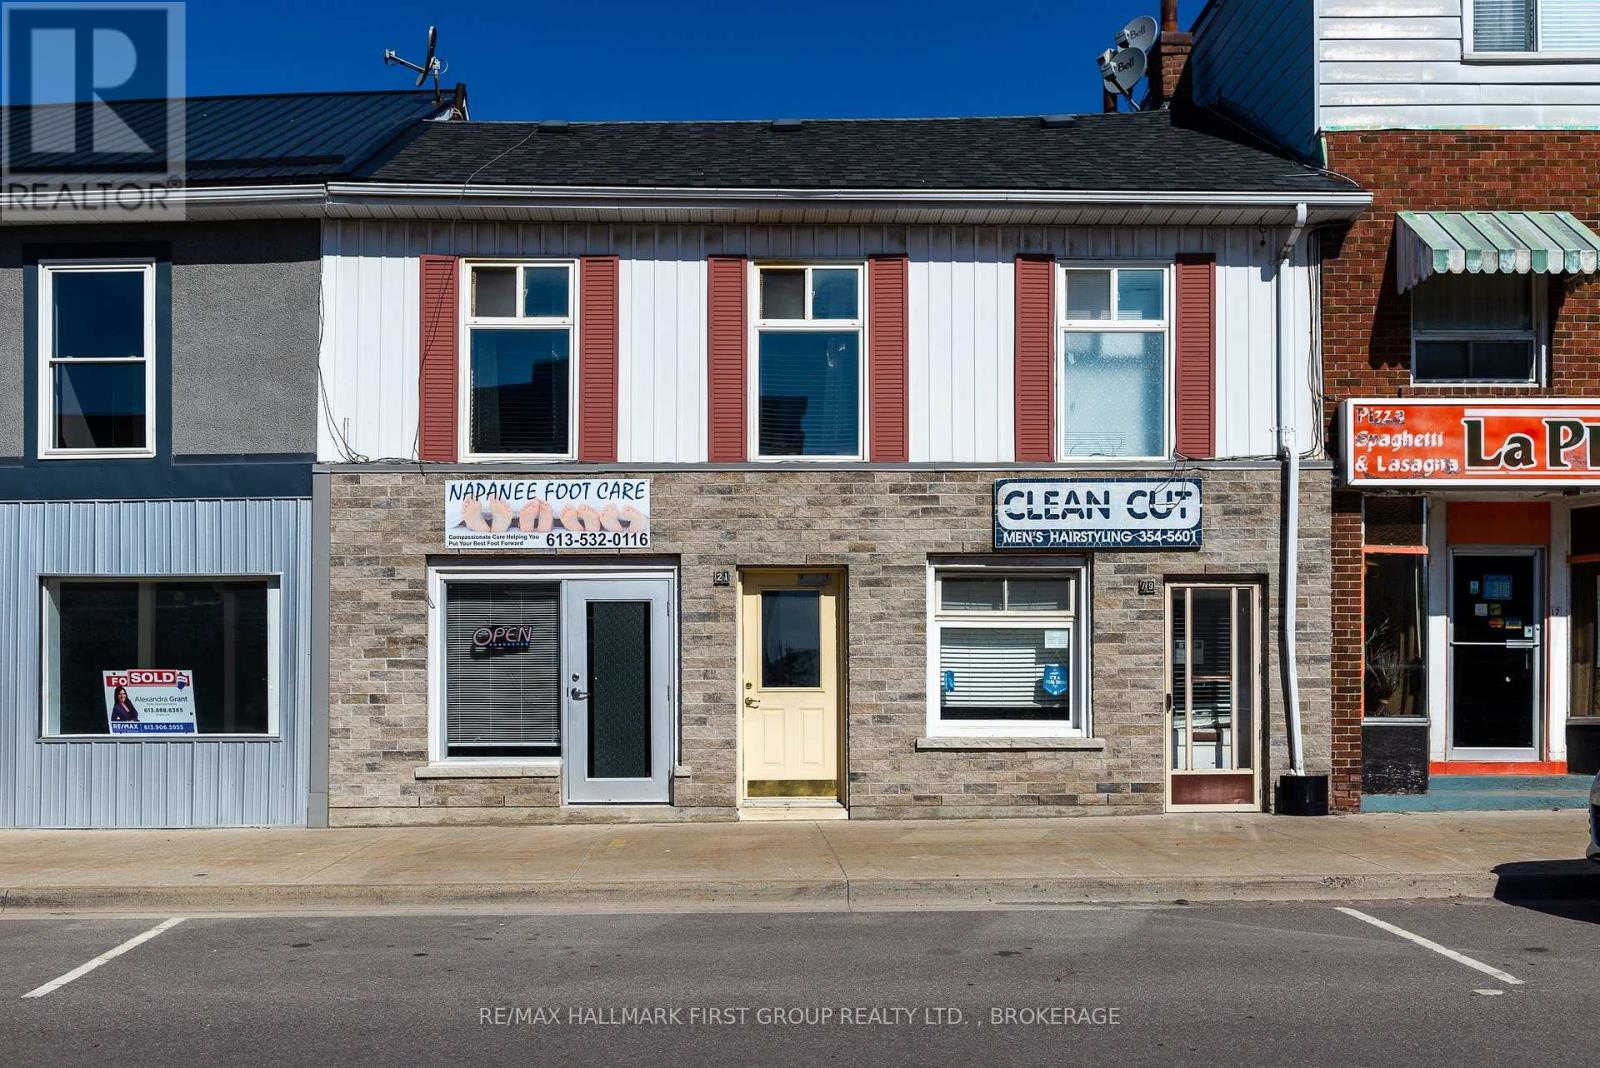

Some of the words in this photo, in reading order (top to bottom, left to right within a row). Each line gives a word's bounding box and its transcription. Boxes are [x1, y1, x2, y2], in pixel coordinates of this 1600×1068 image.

[1130, 25, 1146, 39] Bell
[1117, 57, 1135, 72] Bell
[1356, 406, 1405, 425] Pizza
[1355, 431, 1444, 452] Spaghetti
[1461, 417, 1537, 470] La
[1355, 456, 1368, 473] &
[1377, 455, 1459, 476] Lasagna
[450, 481, 537, 501] NAPANEE
[544, 481, 591, 501] FOOT
[597, 481, 645, 500] CARE
[1003, 489, 1111, 521] CLEAN
[1126, 489, 1193, 520] CUT
[448, 533, 491, 541] Compassionate
[506, 533, 528, 541] Helping
[546, 532, 648, 547] 613-532-0116
[1003, 531, 1043, 543] MEN'S
[1050, 530, 1132, 543] HAIRSTYLING
[1139, 530, 1196, 543] 354-5601
[473, 626, 533, 647] OPEN
[111, 677, 128, 686] FO
[130, 672, 175, 683] SOLD
